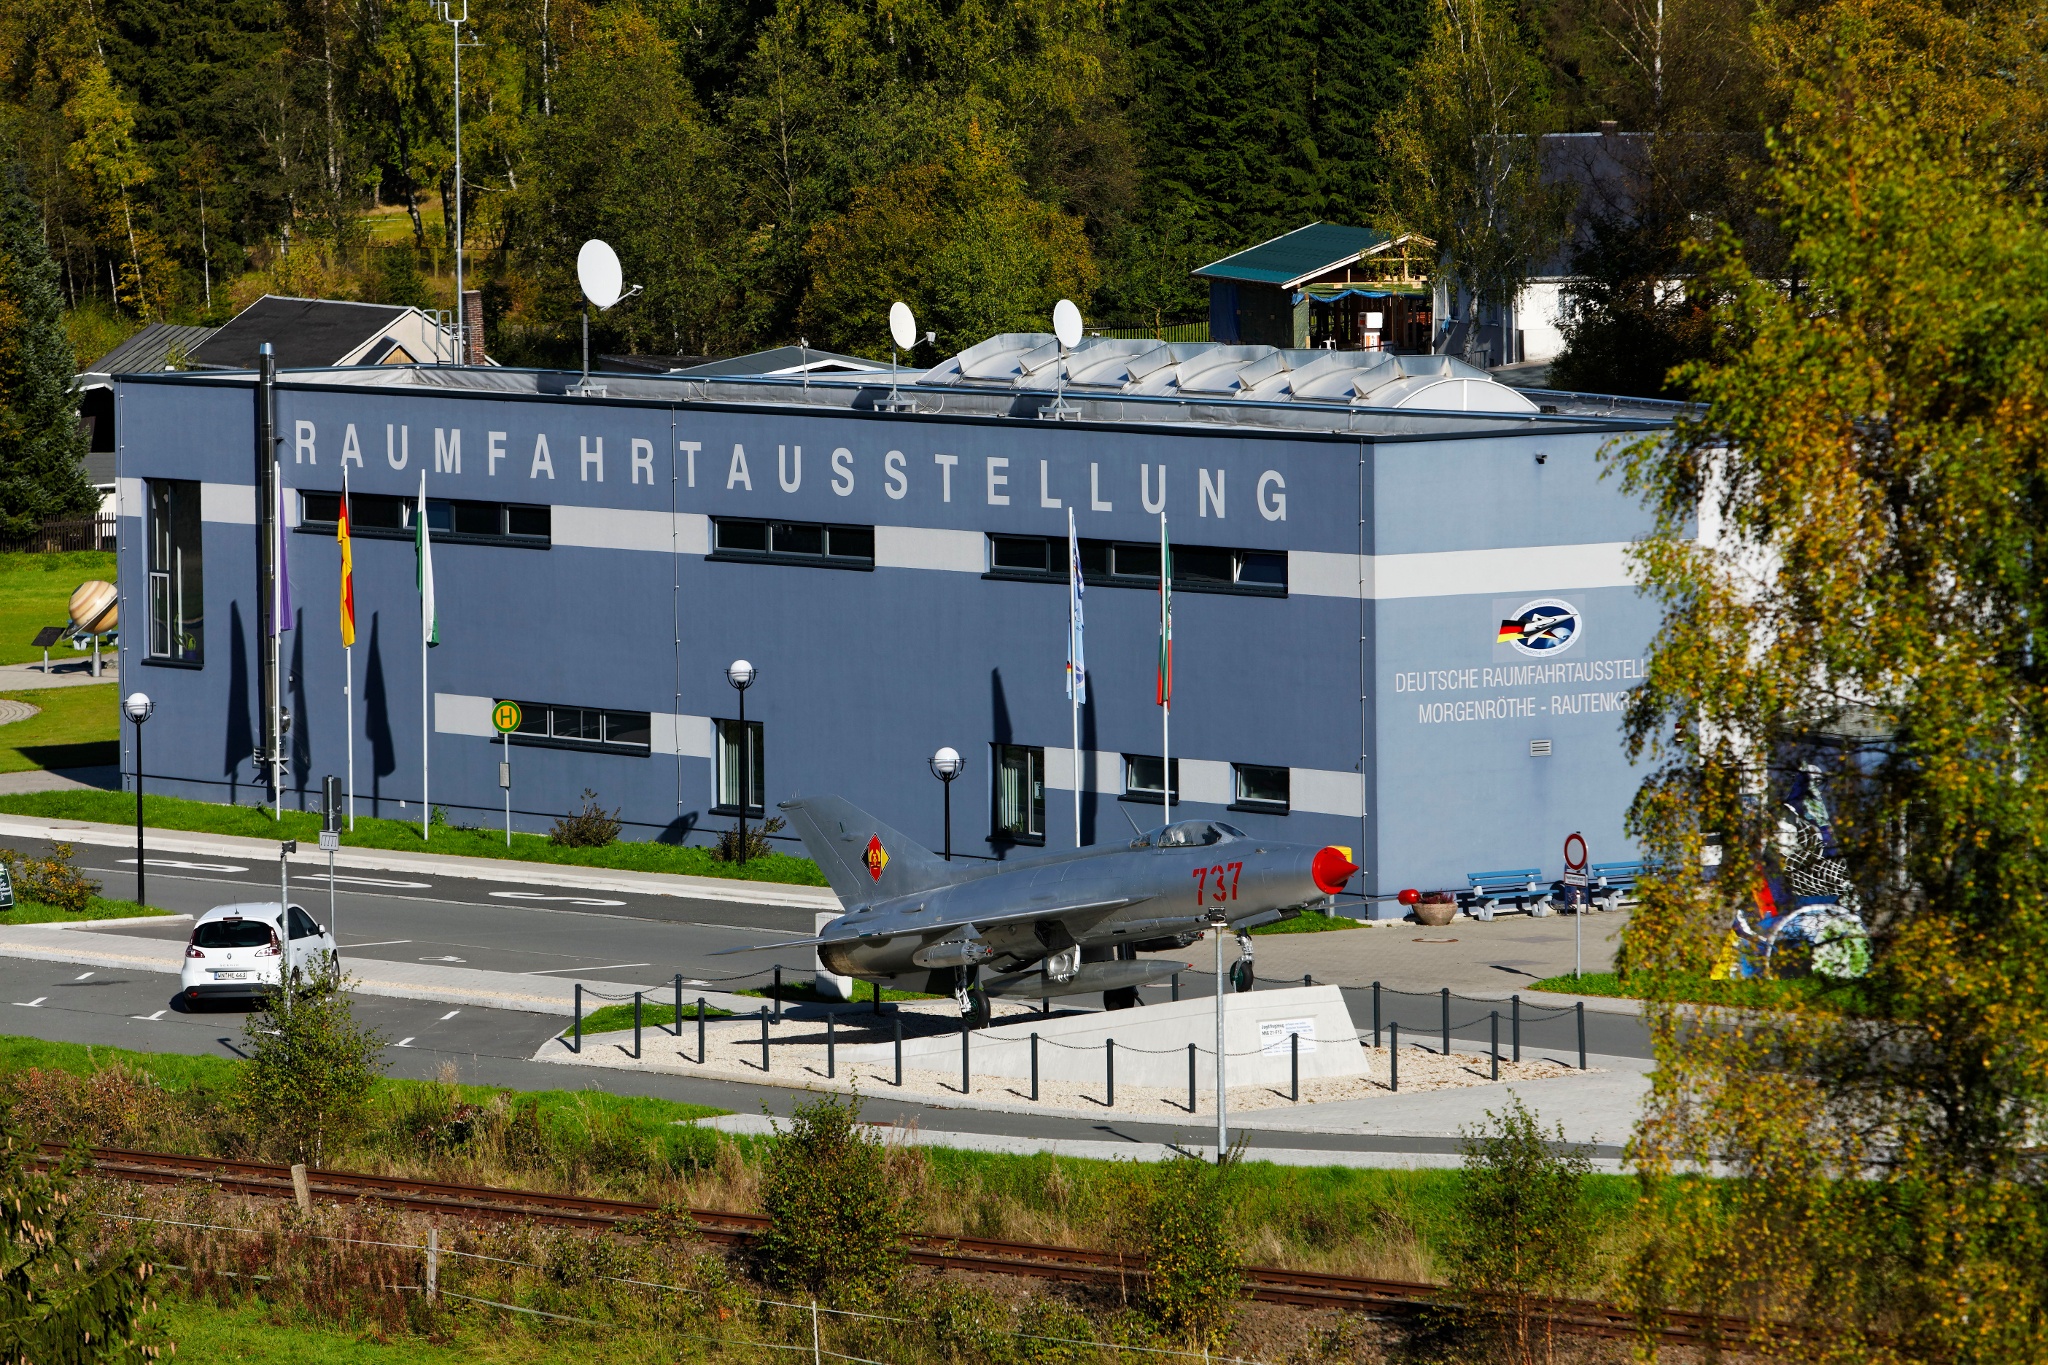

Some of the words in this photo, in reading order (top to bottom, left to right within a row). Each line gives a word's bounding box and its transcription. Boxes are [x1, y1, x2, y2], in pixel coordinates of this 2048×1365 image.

[295, 418, 1288, 522] RAUMFAHRTAUSSTELLUNG
[1395, 668, 1479, 693] DEUTSCHE
[1483, 657, 1650, 688] RAUMFAHRTAUSSTELL
[501, 708, 512, 725] H
[1419, 696, 1536, 724] MORGENRÖTHE
[1192, 861, 1243, 906] 737
